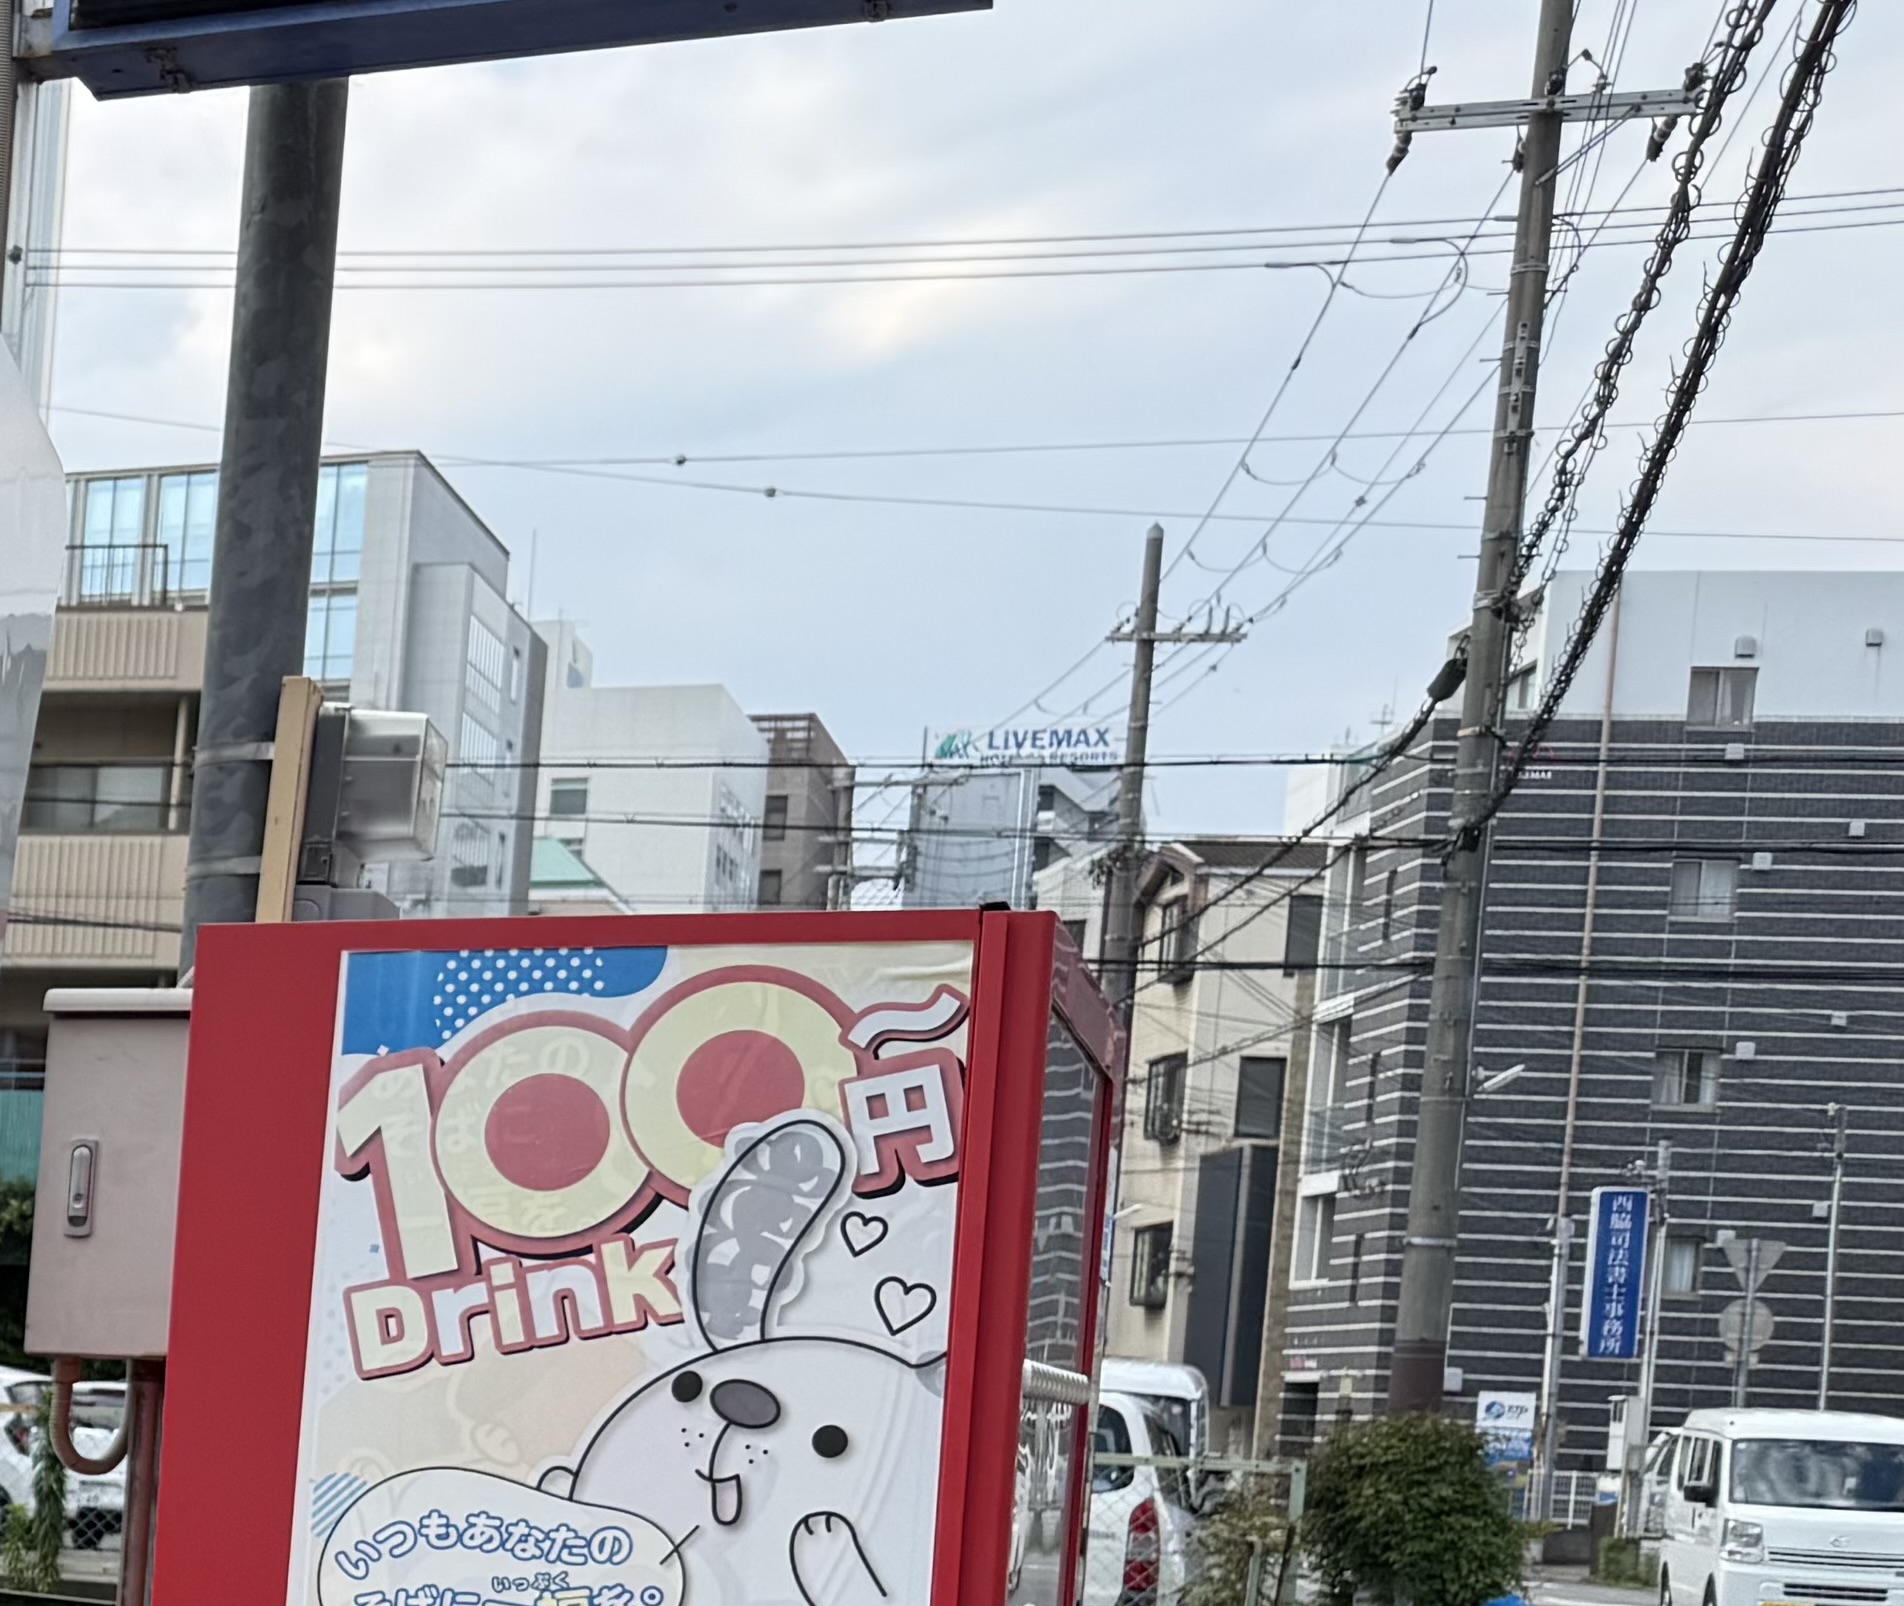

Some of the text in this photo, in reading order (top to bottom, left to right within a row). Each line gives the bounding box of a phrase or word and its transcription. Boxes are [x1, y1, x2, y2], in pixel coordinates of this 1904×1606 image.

[987, 727, 1110, 750] LIVEMAX
[344, 1234, 684, 1379] Drink
[335, 1509, 633, 1580] いつもあなたの
[491, 1570, 570, 1593] いっぷく
